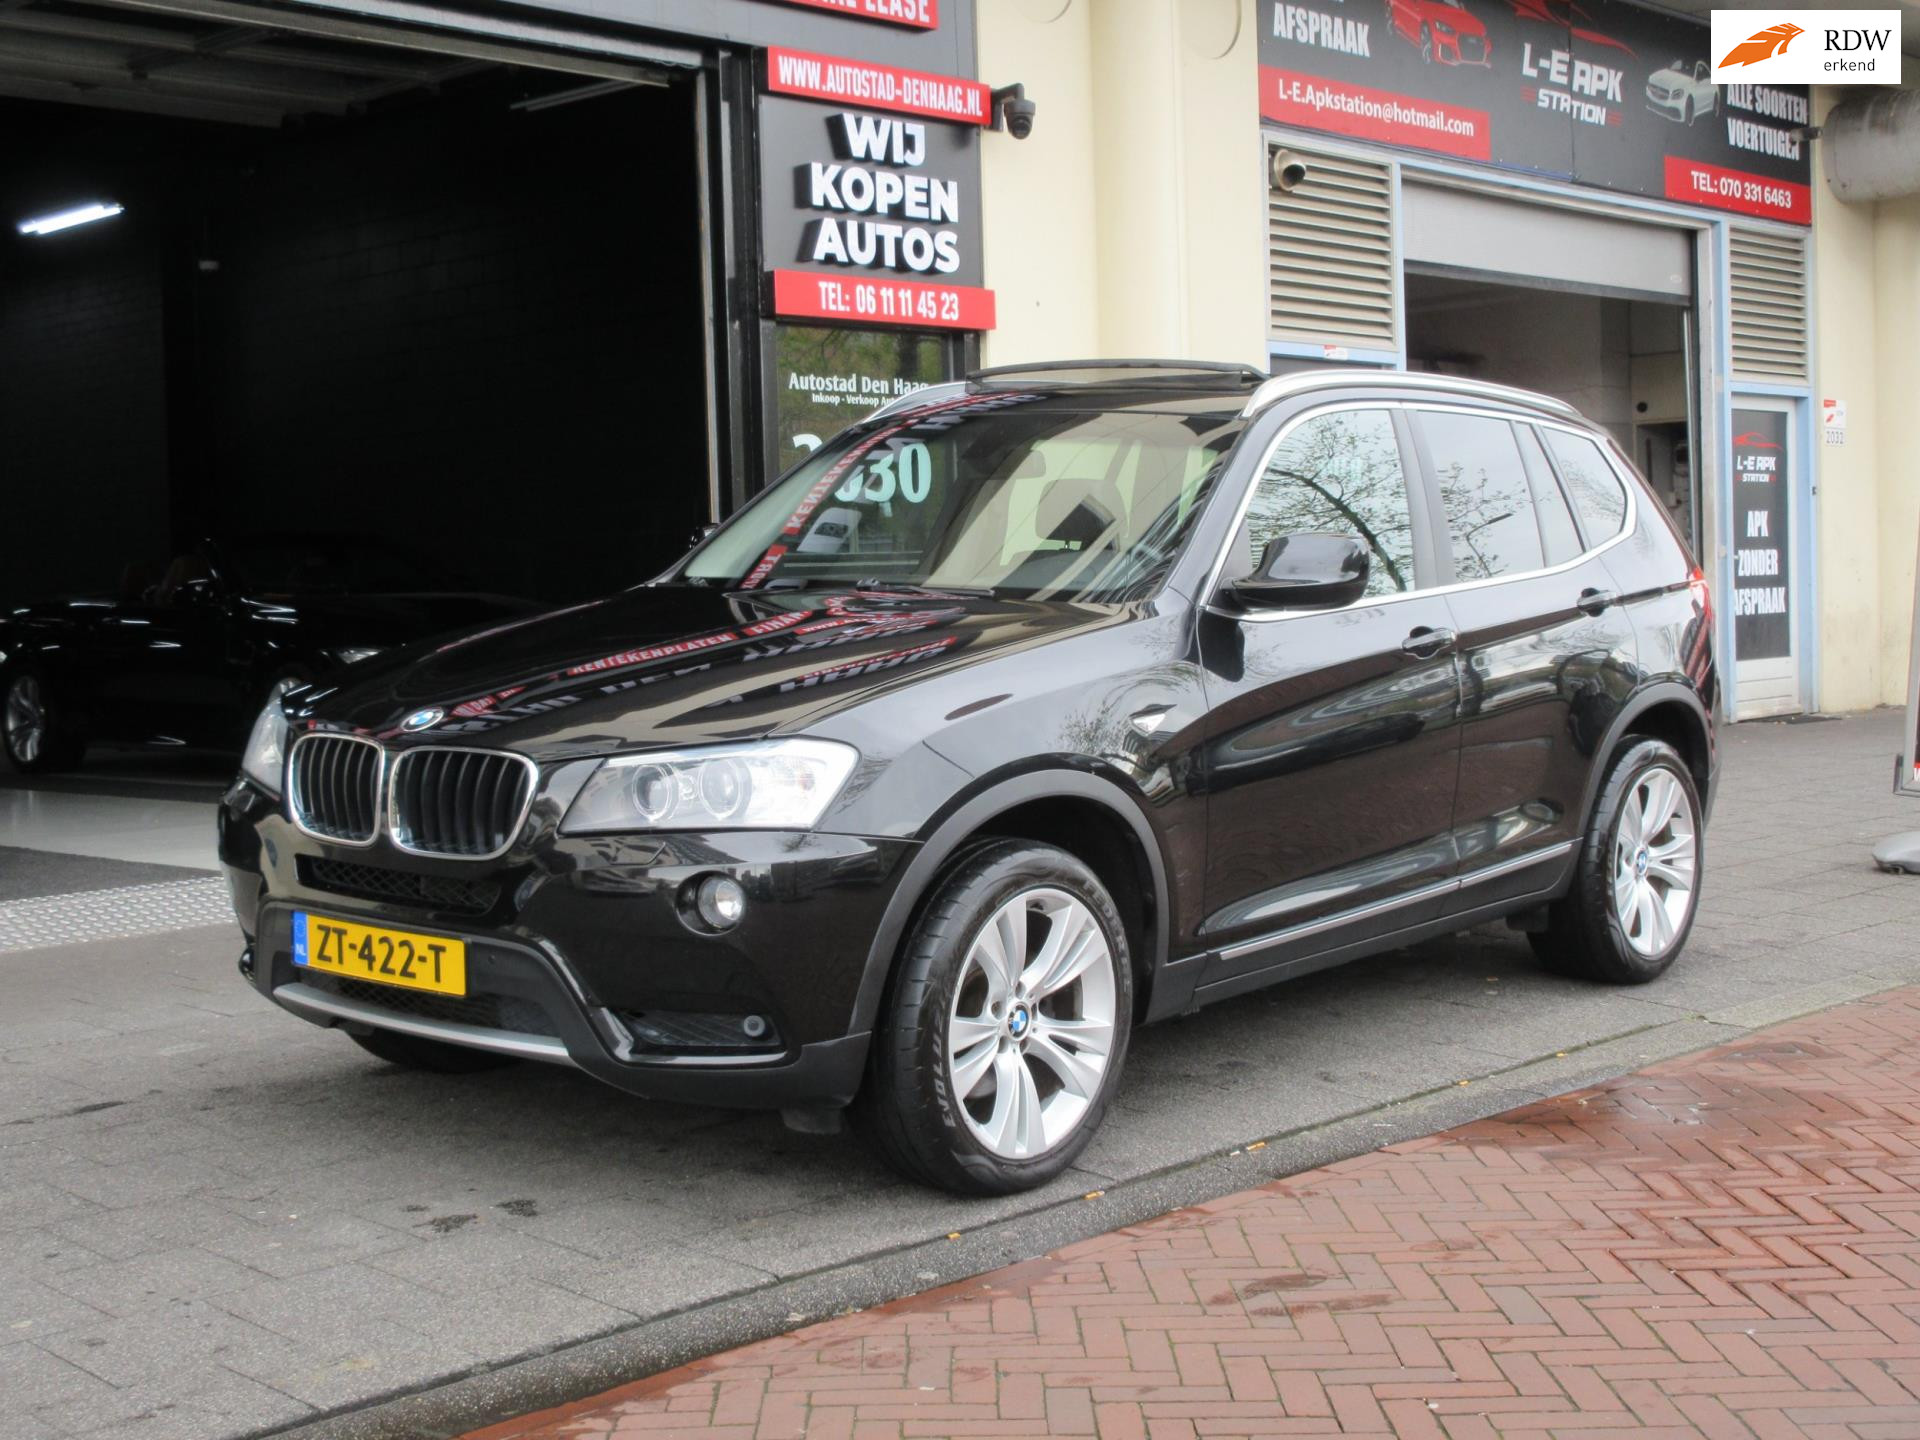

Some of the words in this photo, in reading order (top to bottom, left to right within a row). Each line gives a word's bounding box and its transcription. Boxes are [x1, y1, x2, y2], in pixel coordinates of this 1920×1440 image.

[1273, 2, 1370, 57] AFSPRAAK
[778, 56, 983, 117] WWW.AUTOSTAD-DENHAAG.NL
[1522, 42, 1570, 85] L-E
[1572, 60, 1624, 103] APK
[1279, 79, 1474, 137] L-E.Apkstation@hotmail.com
[1537, 88, 1607, 126] STATION
[1727, 84, 1753, 111] ALLE
[1755, 86, 1808, 125] SOORTEN
[843, 113, 926, 166] WIJ
[810, 162, 959, 223] KOPEN
[1691, 170, 1718, 193] TEL:
[1720, 177, 1741, 198] 070
[1744, 182, 1762, 202] 331
[1764, 186, 1792, 208] 6463
[813, 217, 960, 273] AUTOS
[818, 281, 850, 312] TEL:
[856, 284, 876, 314] 06
[880, 287, 895, 316] 11
[898, 288, 913, 317] 11
[917, 291, 936, 319] 45
[941, 292, 959, 320] 23
[789, 372, 857, 392] Autostad
[861, 376, 889, 394] Den
[812, 393, 840, 406] Inkoop
[846, 394, 879, 408] Verkoop
[1747, 510, 1769, 538] APK
[1738, 549, 1778, 576] ZONDER
[1734, 587, 1786, 615] AFSPRAAK
[317, 924, 446, 983] ZT-422-T
